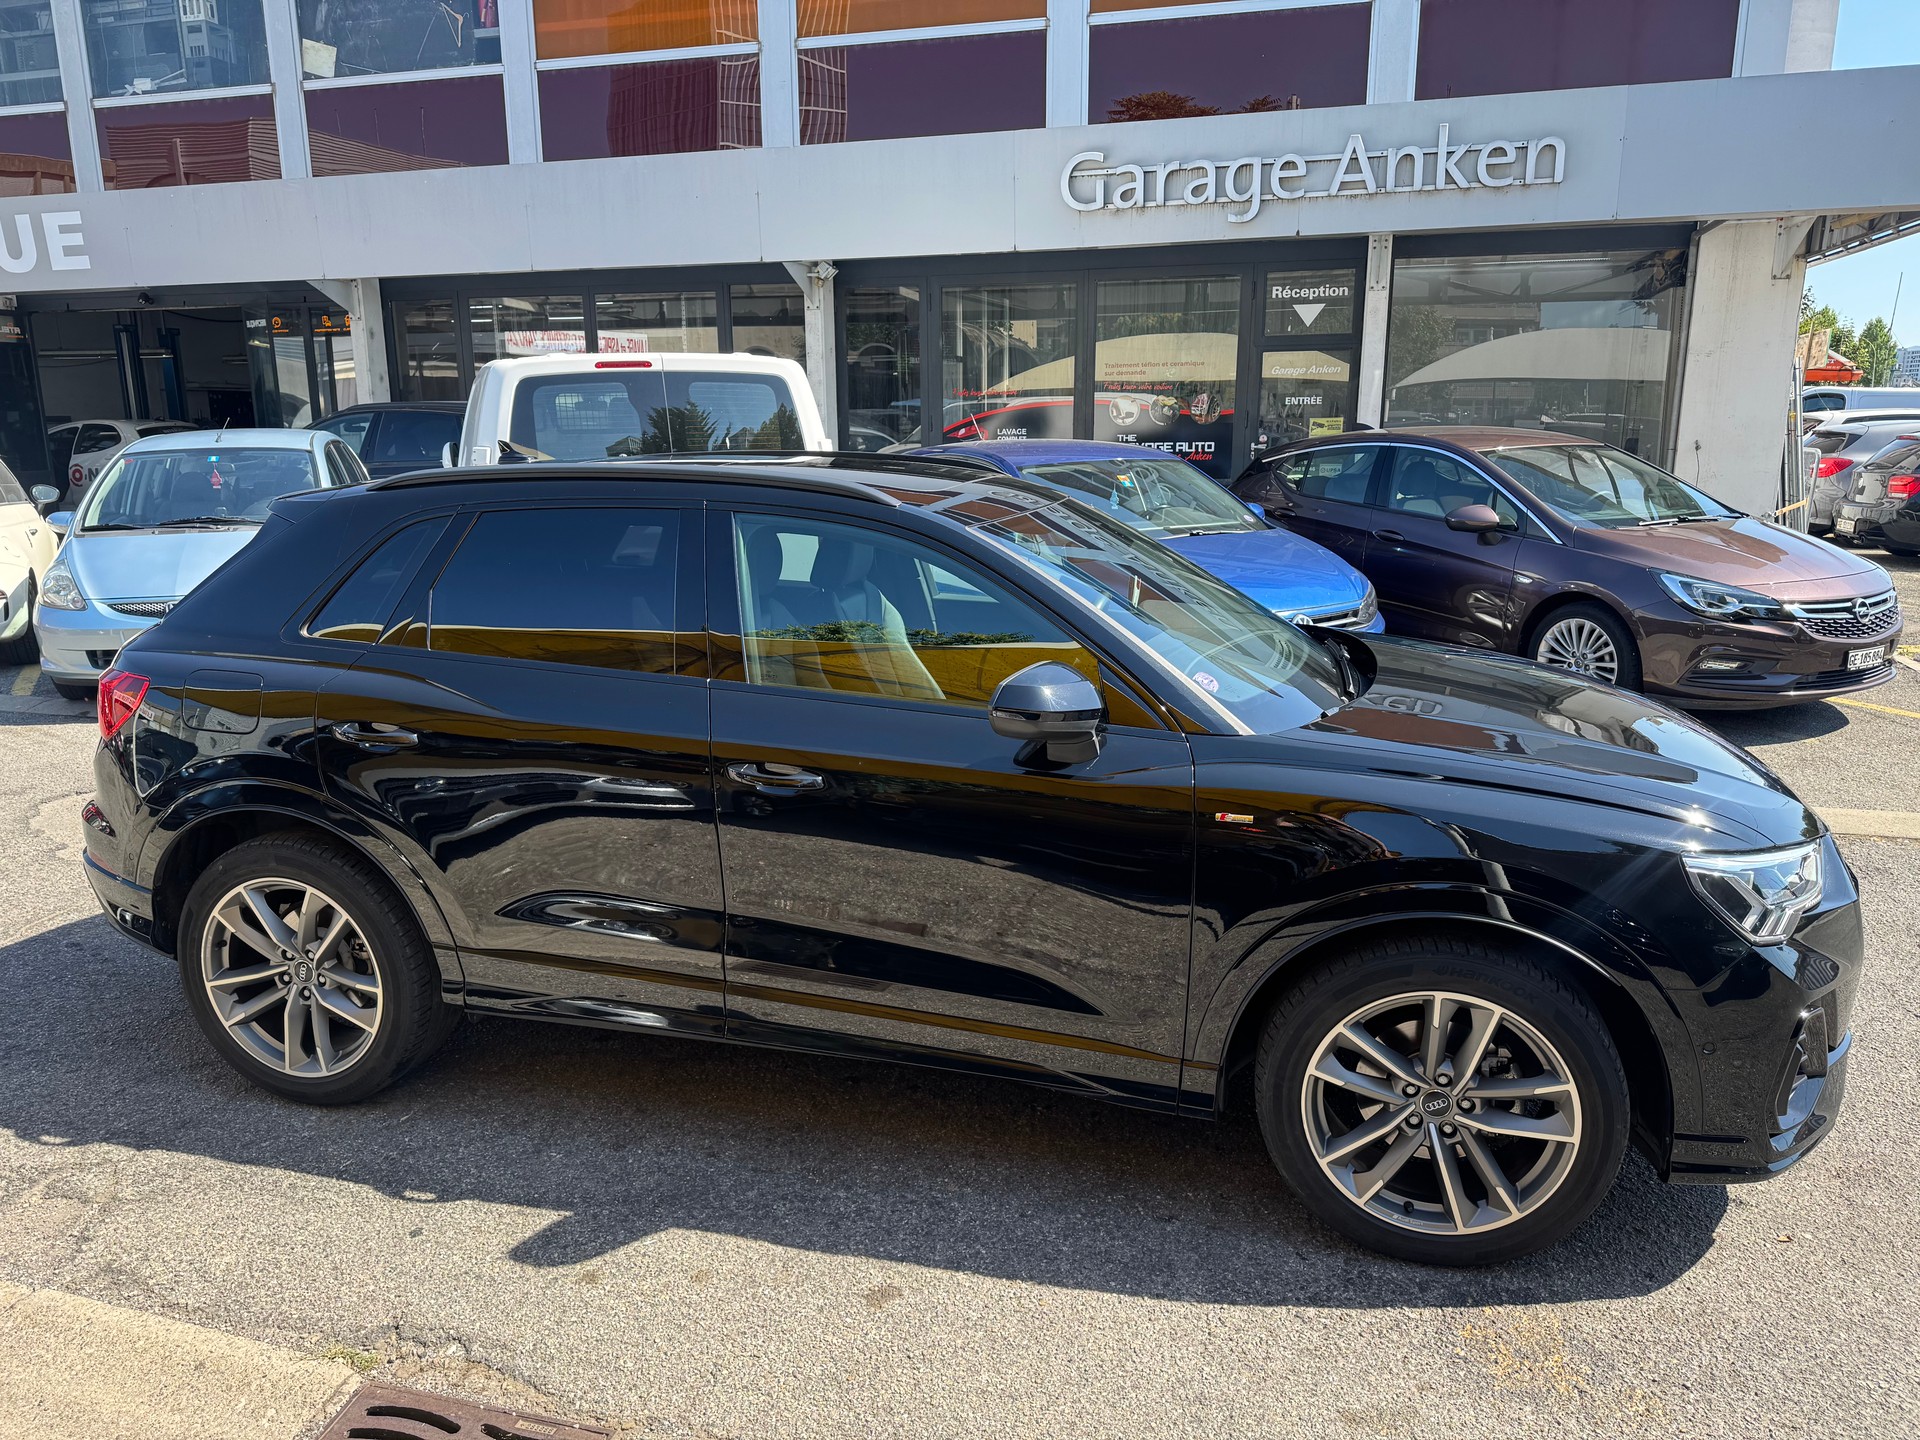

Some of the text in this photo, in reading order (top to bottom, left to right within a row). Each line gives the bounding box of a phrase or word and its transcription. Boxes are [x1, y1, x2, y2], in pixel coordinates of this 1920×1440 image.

[1060, 123, 1566, 224] Garage Anken
[0, 211, 91, 274] UE
[1271, 284, 1349, 300] Réception
[1271, 365, 1341, 376] Garage Anken
[1285, 396, 1323, 405] ENTRÉE
[1117, 434, 1137, 442] THE
[1175, 442, 1215, 452] AUTO
